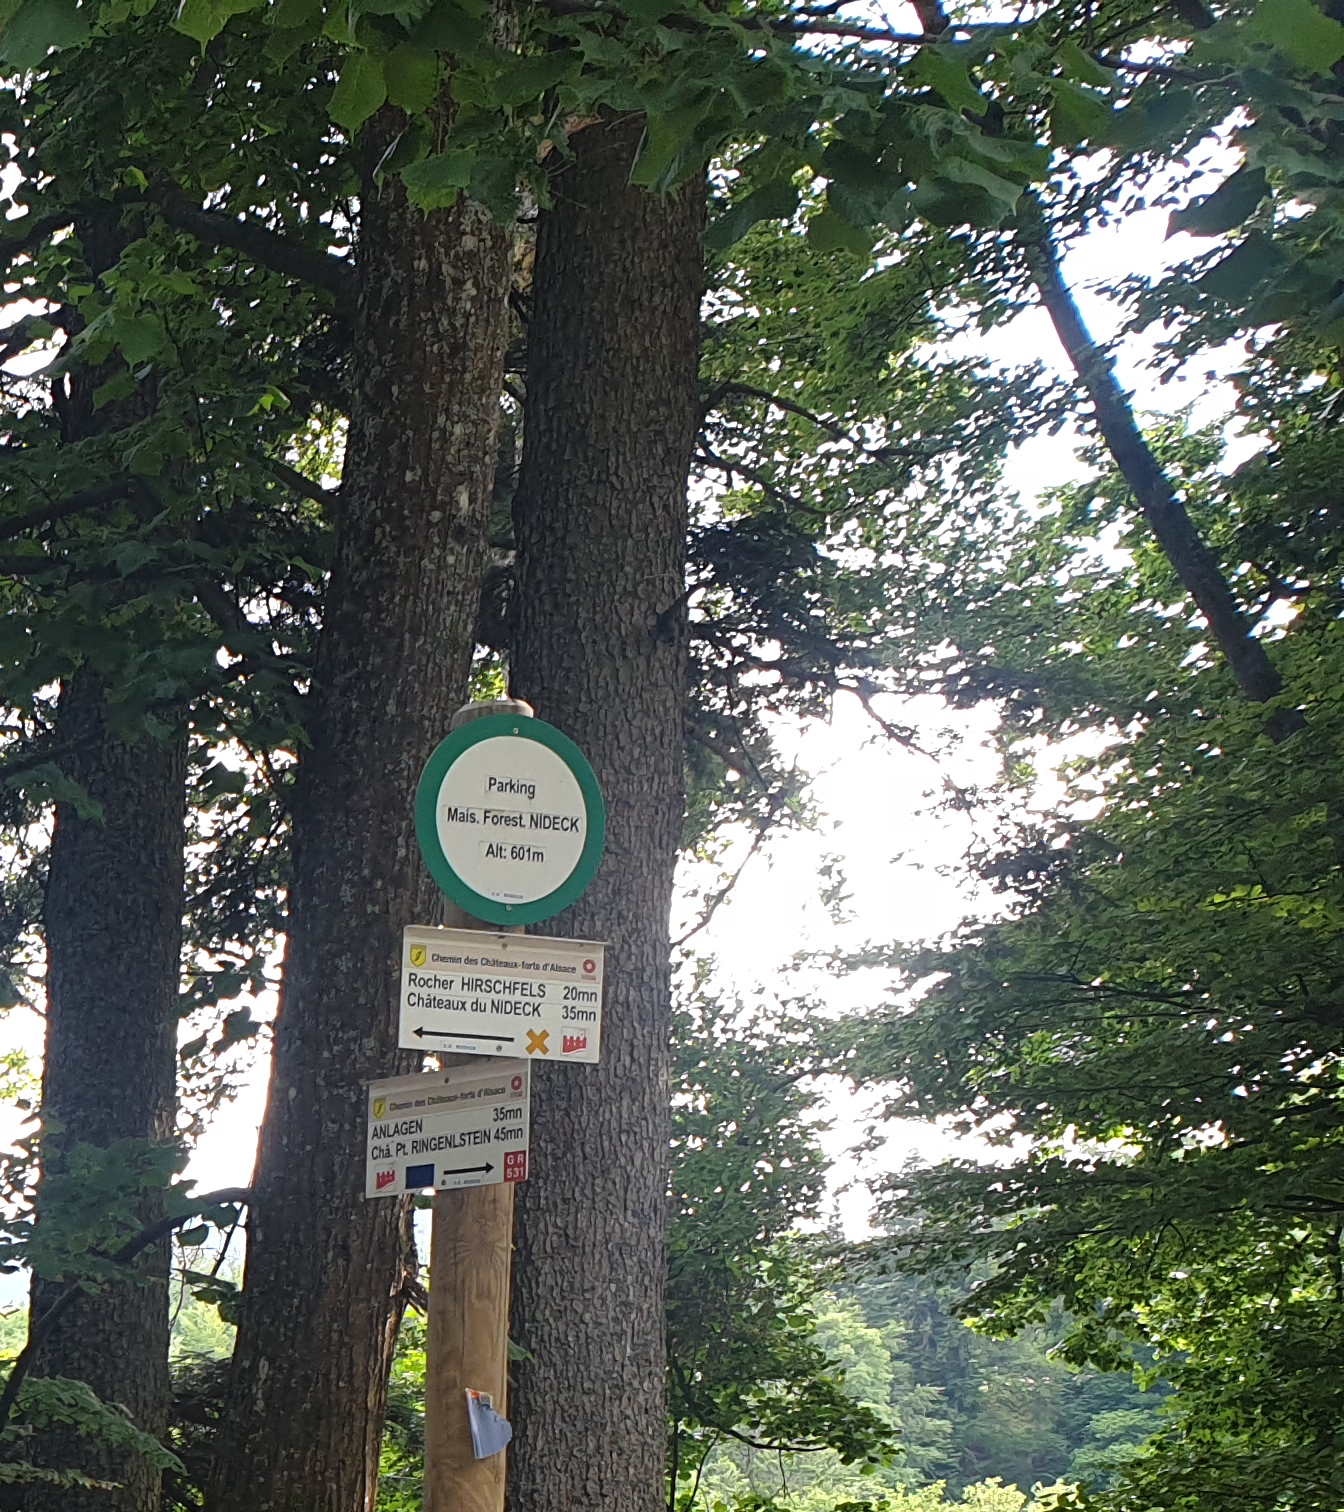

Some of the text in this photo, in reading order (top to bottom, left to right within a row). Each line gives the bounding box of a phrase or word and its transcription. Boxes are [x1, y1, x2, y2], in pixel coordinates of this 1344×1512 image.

[488, 777, 536, 800] Parking
[447, 807, 580, 833] Mais. Forest. NIDECK
[485, 843, 544, 863] Alt: 601m
[408, 972, 598, 1003] Rocher HIRSCHFELS 20mn
[407, 992, 597, 1022] Châteaux du NIDECK 35mn
[371, 1107, 522, 1140] ANLAGEN 35mn
[411, 1129, 491, 1155] RINGENLSTEIN
[493, 1127, 523, 1142] 45mn
[506, 1166, 524, 1179] 531
